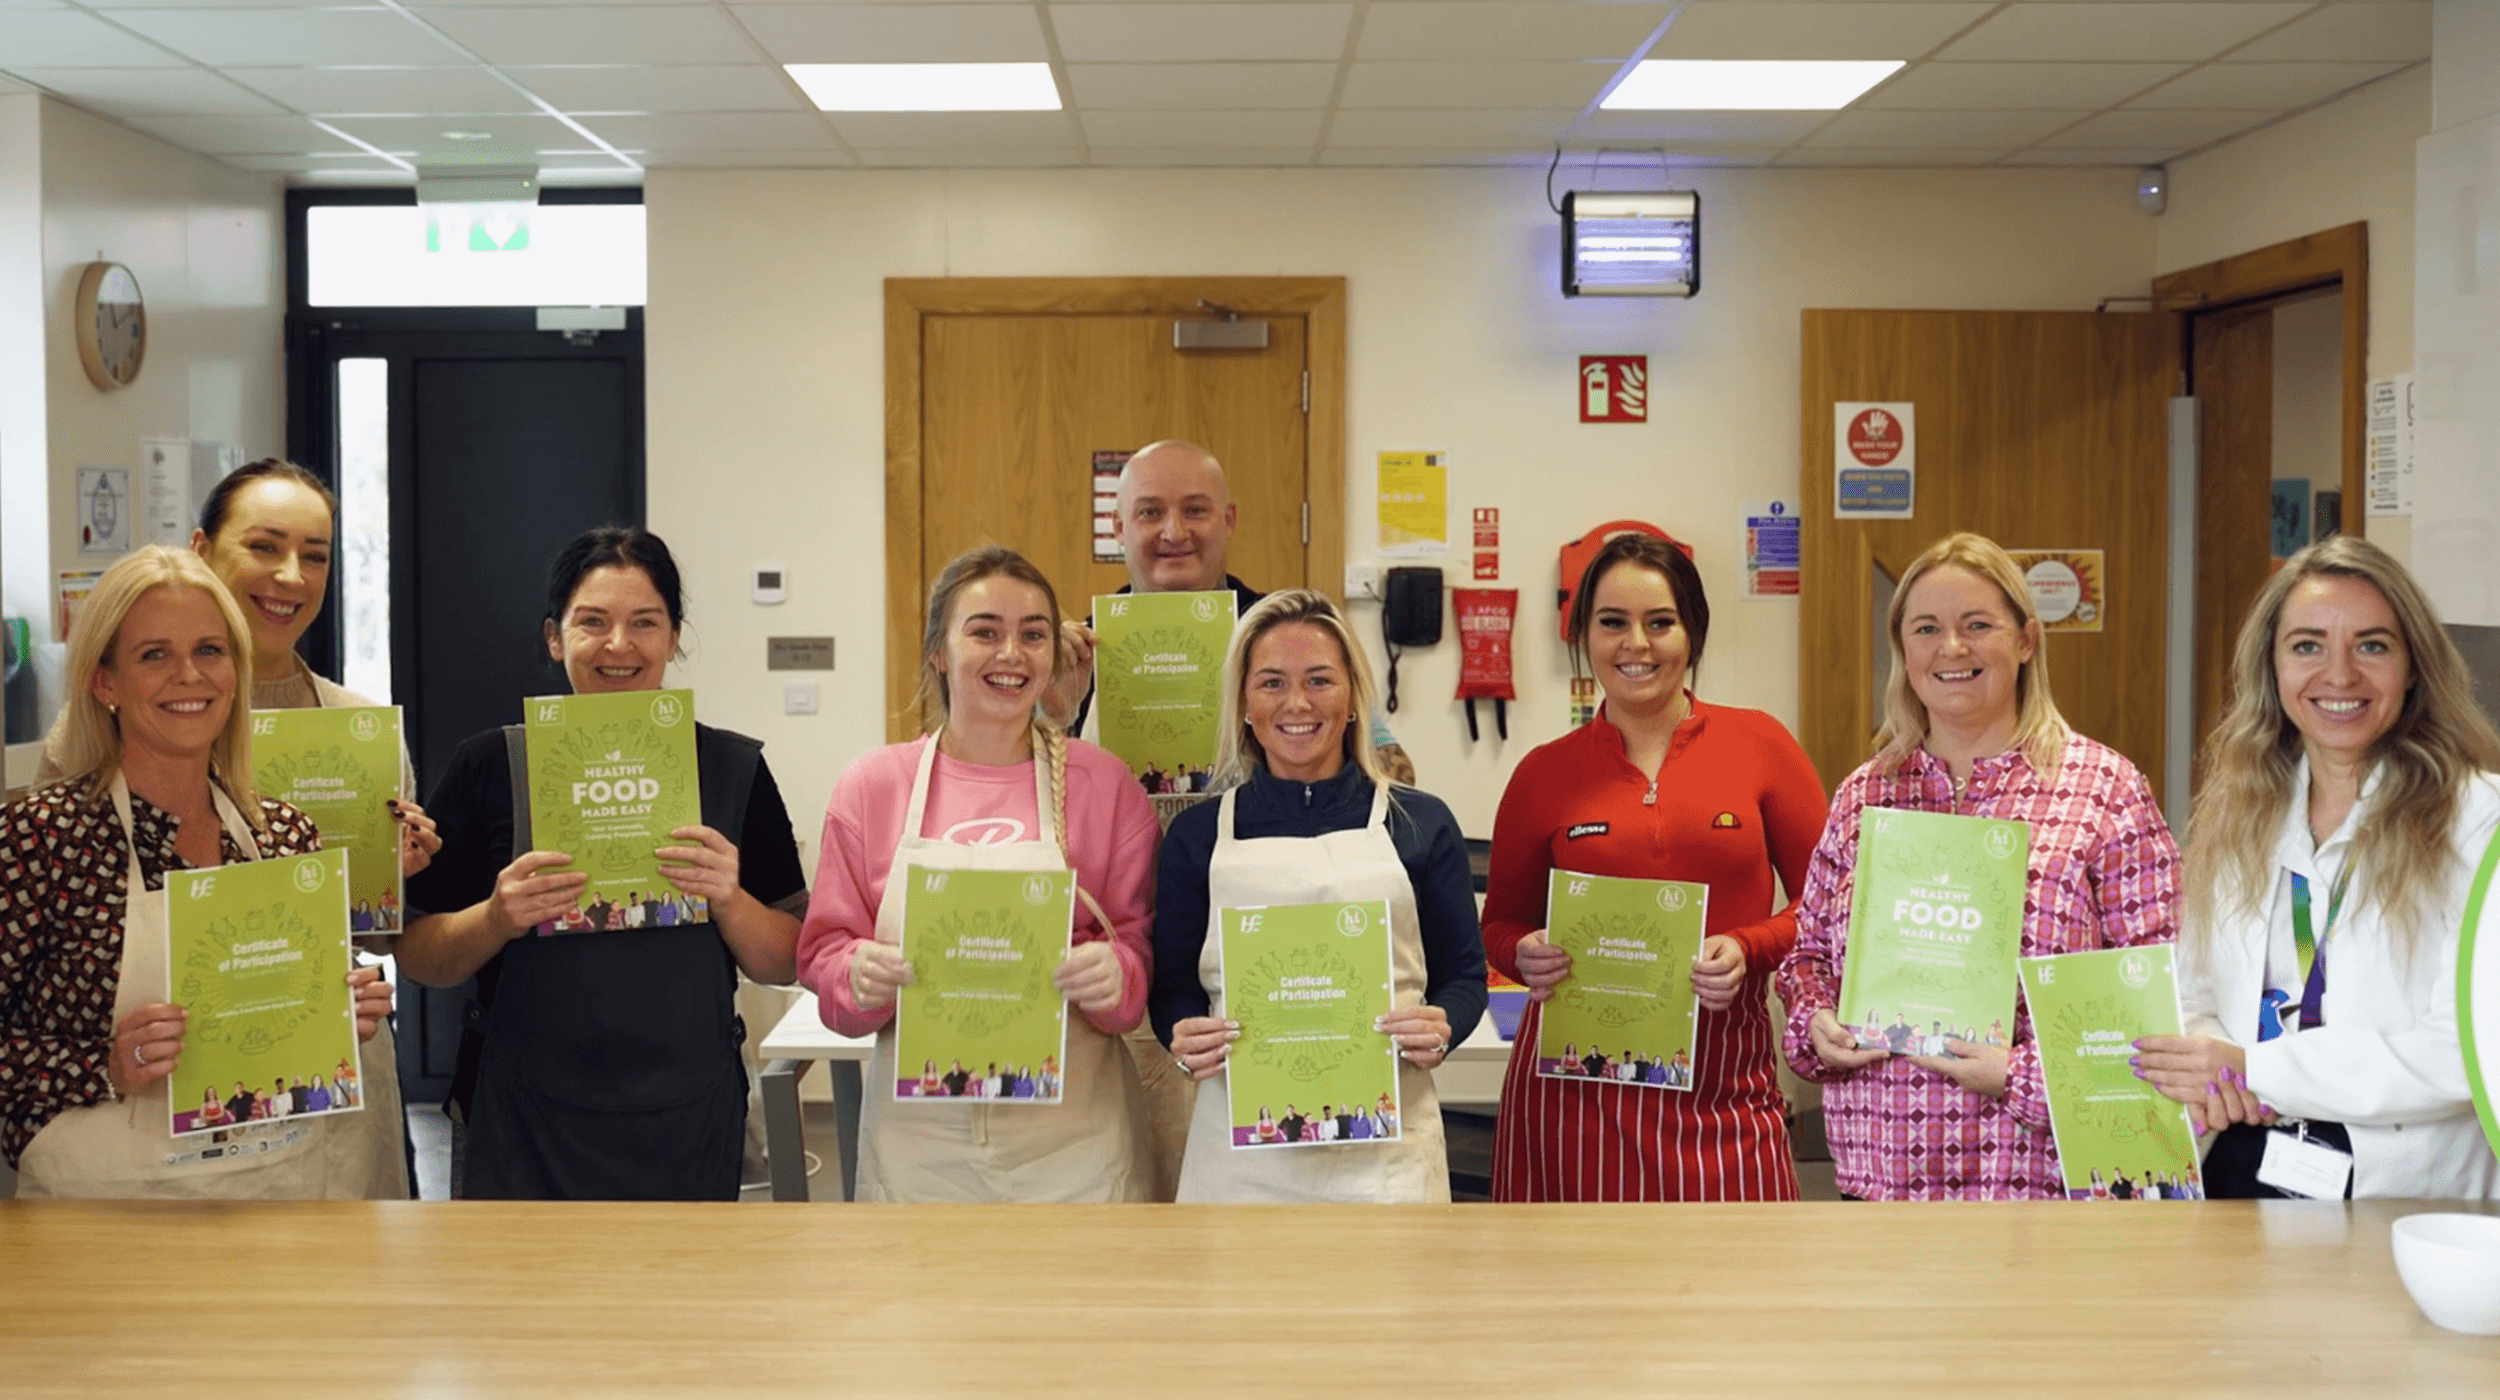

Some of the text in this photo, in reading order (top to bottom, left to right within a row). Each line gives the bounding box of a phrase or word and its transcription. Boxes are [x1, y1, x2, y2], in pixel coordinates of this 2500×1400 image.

[1143, 652, 1187, 663] Certificate
[1132, 664, 1199, 675] of Participation
[584, 764, 646, 779] HEALTHY
[292, 777, 345, 789] Certificate
[293, 790, 358, 802] Participation
[571, 777, 660, 806] FOOD
[581, 803, 653, 818] MADE EASY
[1568, 825, 1608, 839] ellesse
[1909, 887, 1971, 903] HEALTHY
[1892, 899, 1982, 930] FOOD
[958, 935, 1011, 948] Certificate
[1899, 927, 1971, 944] MADE EASY
[232, 937, 289, 956] Certificate
[1599, 936, 1647, 950] Certificate
[958, 947, 1024, 962] Participation
[1597, 946, 1658, 962] Participation
[218, 958, 230, 973] of
[232, 950, 303, 970] Participation
[1279, 975, 1333, 988] Certificate
[1267, 988, 1347, 1002] of Participation
[2081, 1030, 2125, 1042] Certificate
